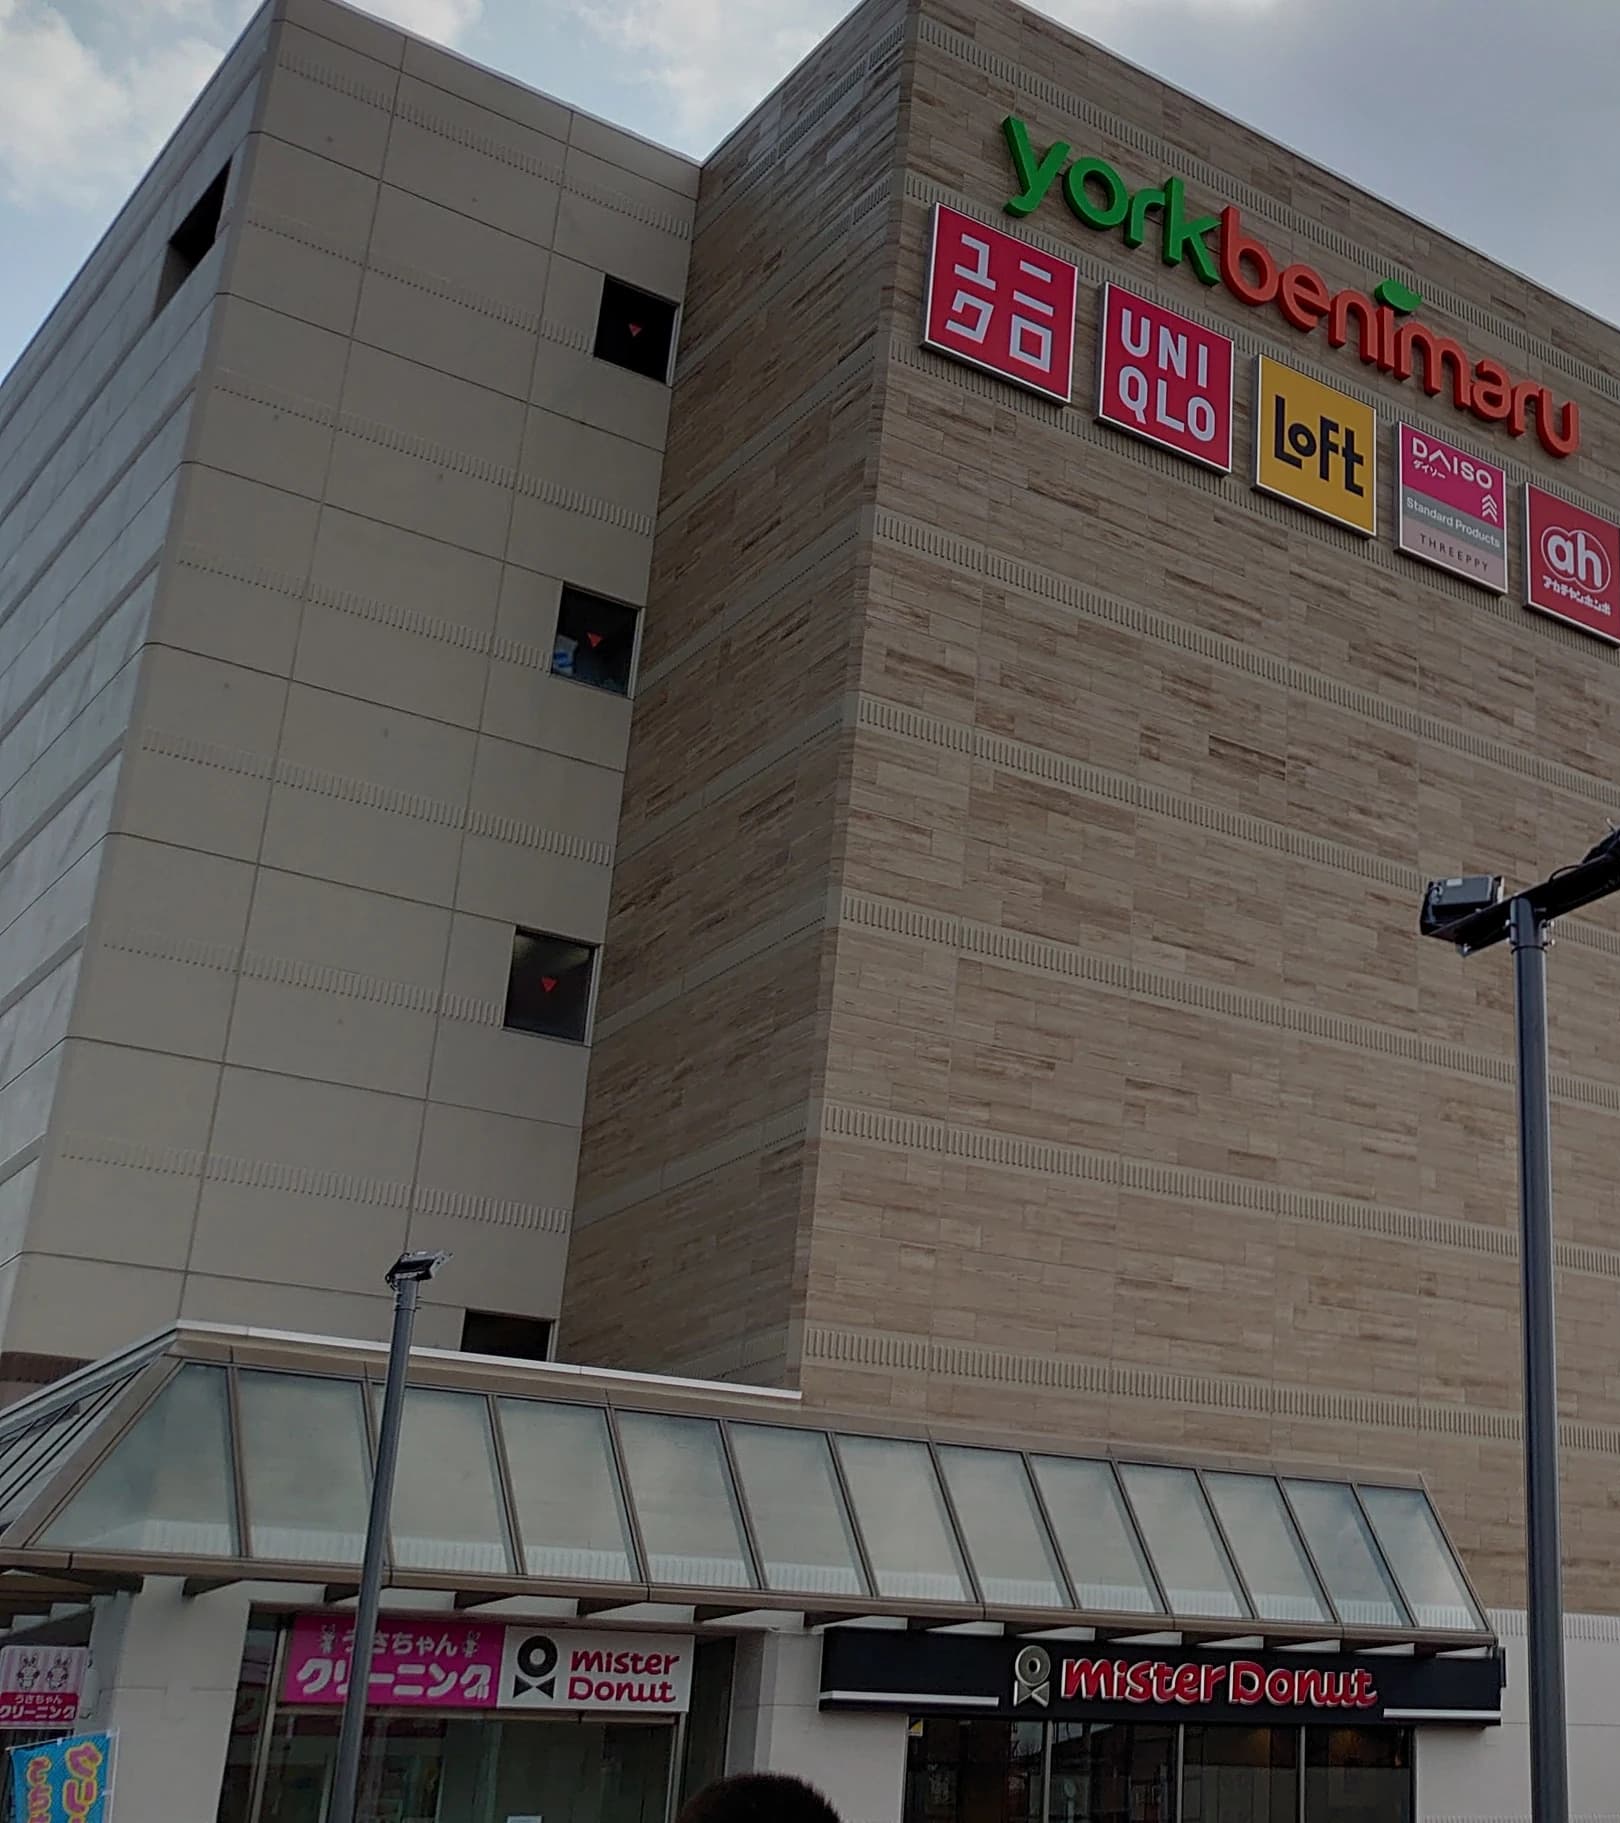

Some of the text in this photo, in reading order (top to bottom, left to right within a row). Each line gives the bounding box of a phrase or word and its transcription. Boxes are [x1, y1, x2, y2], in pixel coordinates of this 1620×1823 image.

[1120, 308, 1208, 389] UNI
[1118, 366, 1216, 442] QLO
[1412, 437, 1493, 489] DAISO
[1412, 459, 1447, 480] ダイソー
[1406, 496, 1501, 548] Standard Products
[1419, 533, 1489, 573] THREEPPY
[1547, 531, 1602, 588] ah
[296, 1657, 493, 1701] クリーニング
[570, 1650, 681, 1675] Mister
[1061, 1658, 1378, 1708] Mister Donut
[567, 1676, 677, 1703] Donut
